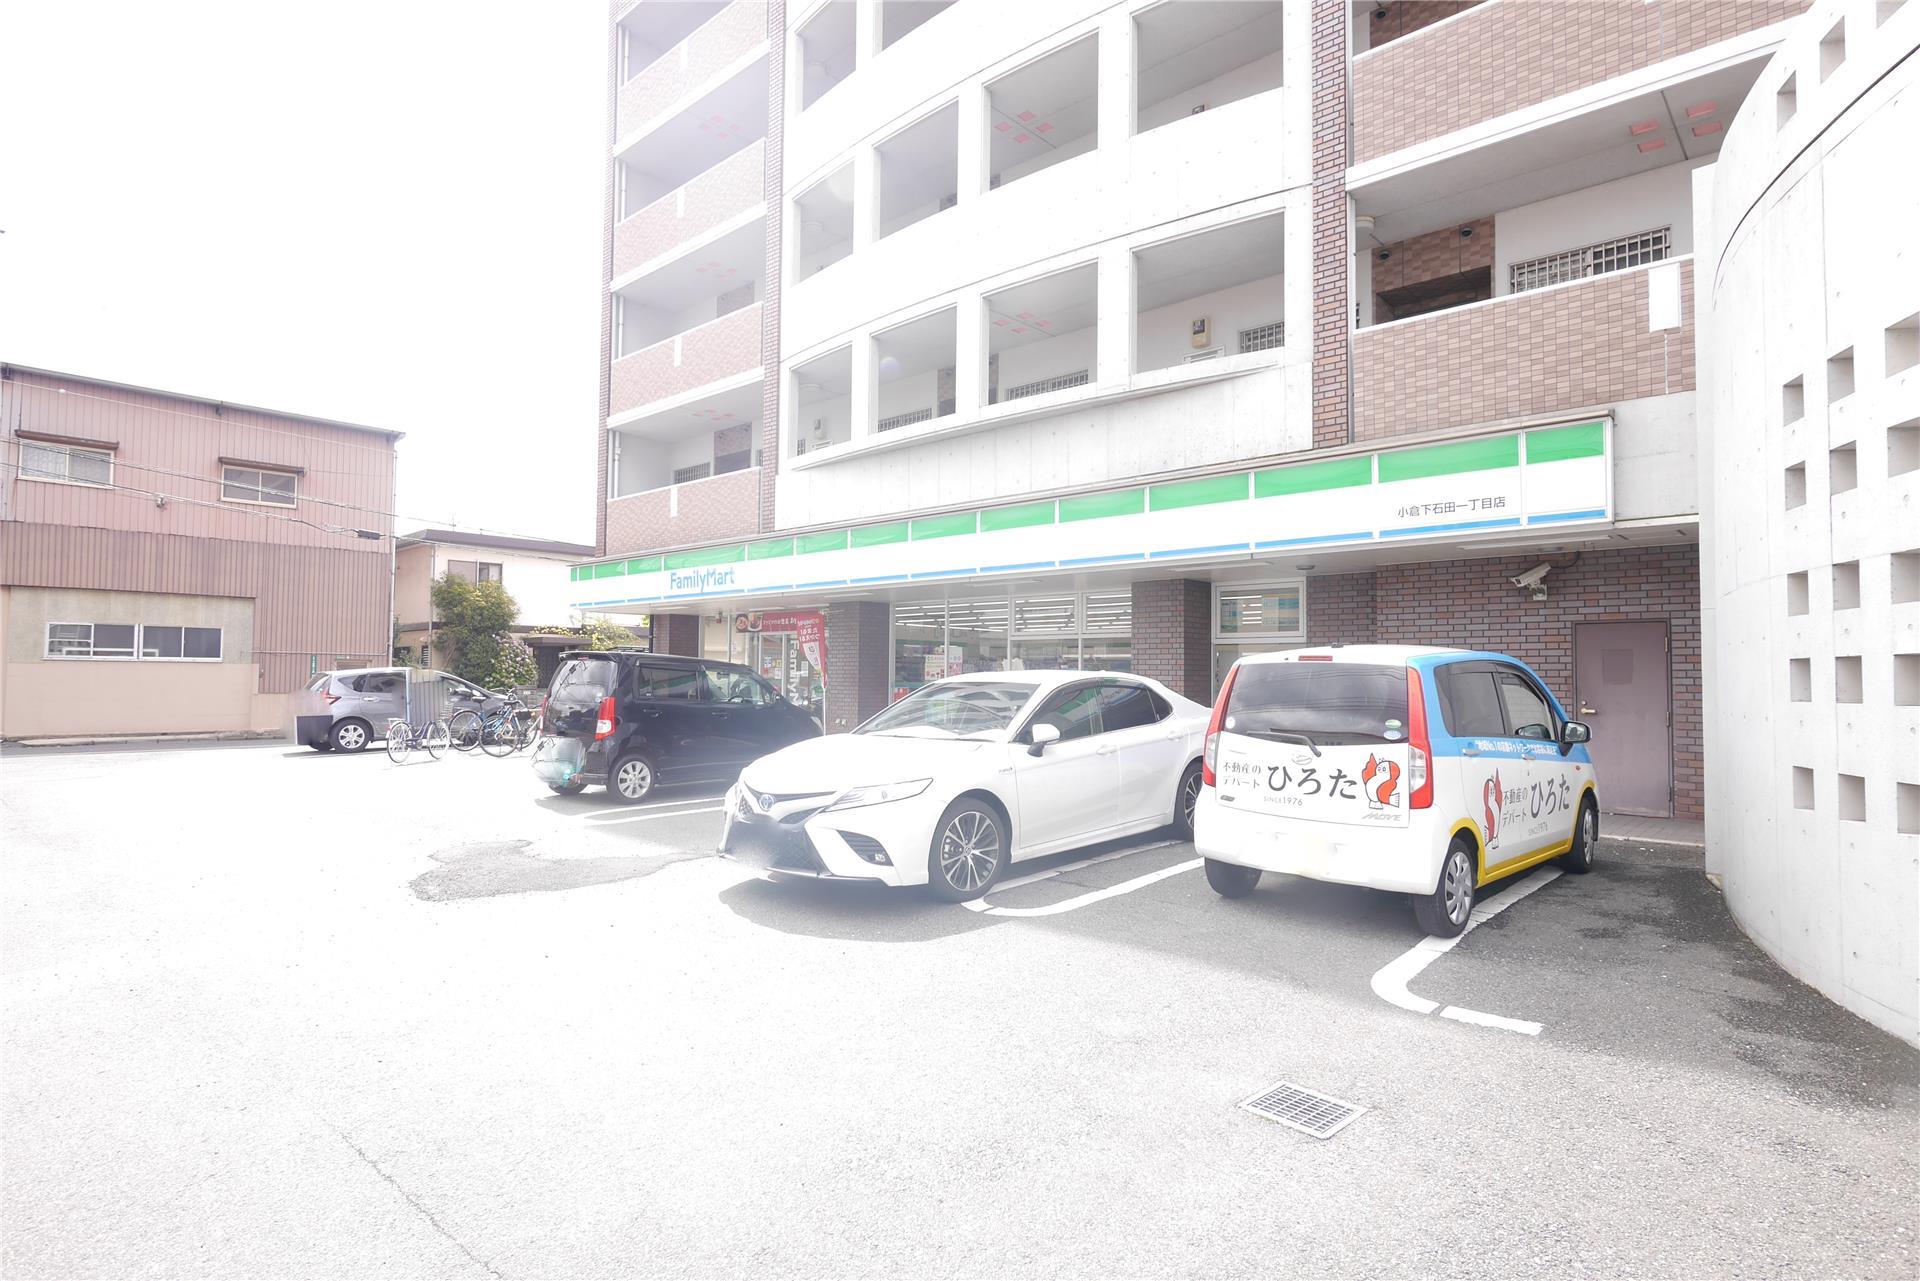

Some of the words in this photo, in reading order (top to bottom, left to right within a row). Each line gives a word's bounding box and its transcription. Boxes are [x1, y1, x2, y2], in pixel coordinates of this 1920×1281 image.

[1397, 496, 1506, 518] 小倉下石田一丁目店
[670, 566, 735, 594] FamilyMart
[1223, 761, 1262, 777] 不動産の
[1267, 765, 1358, 800] ひろた
[1504, 787, 1528, 806] 不動産の
[1531, 773, 1570, 819] ひろた
[1361, 812, 1402, 822] MOVE
[1502, 808, 1527, 828] デパート
